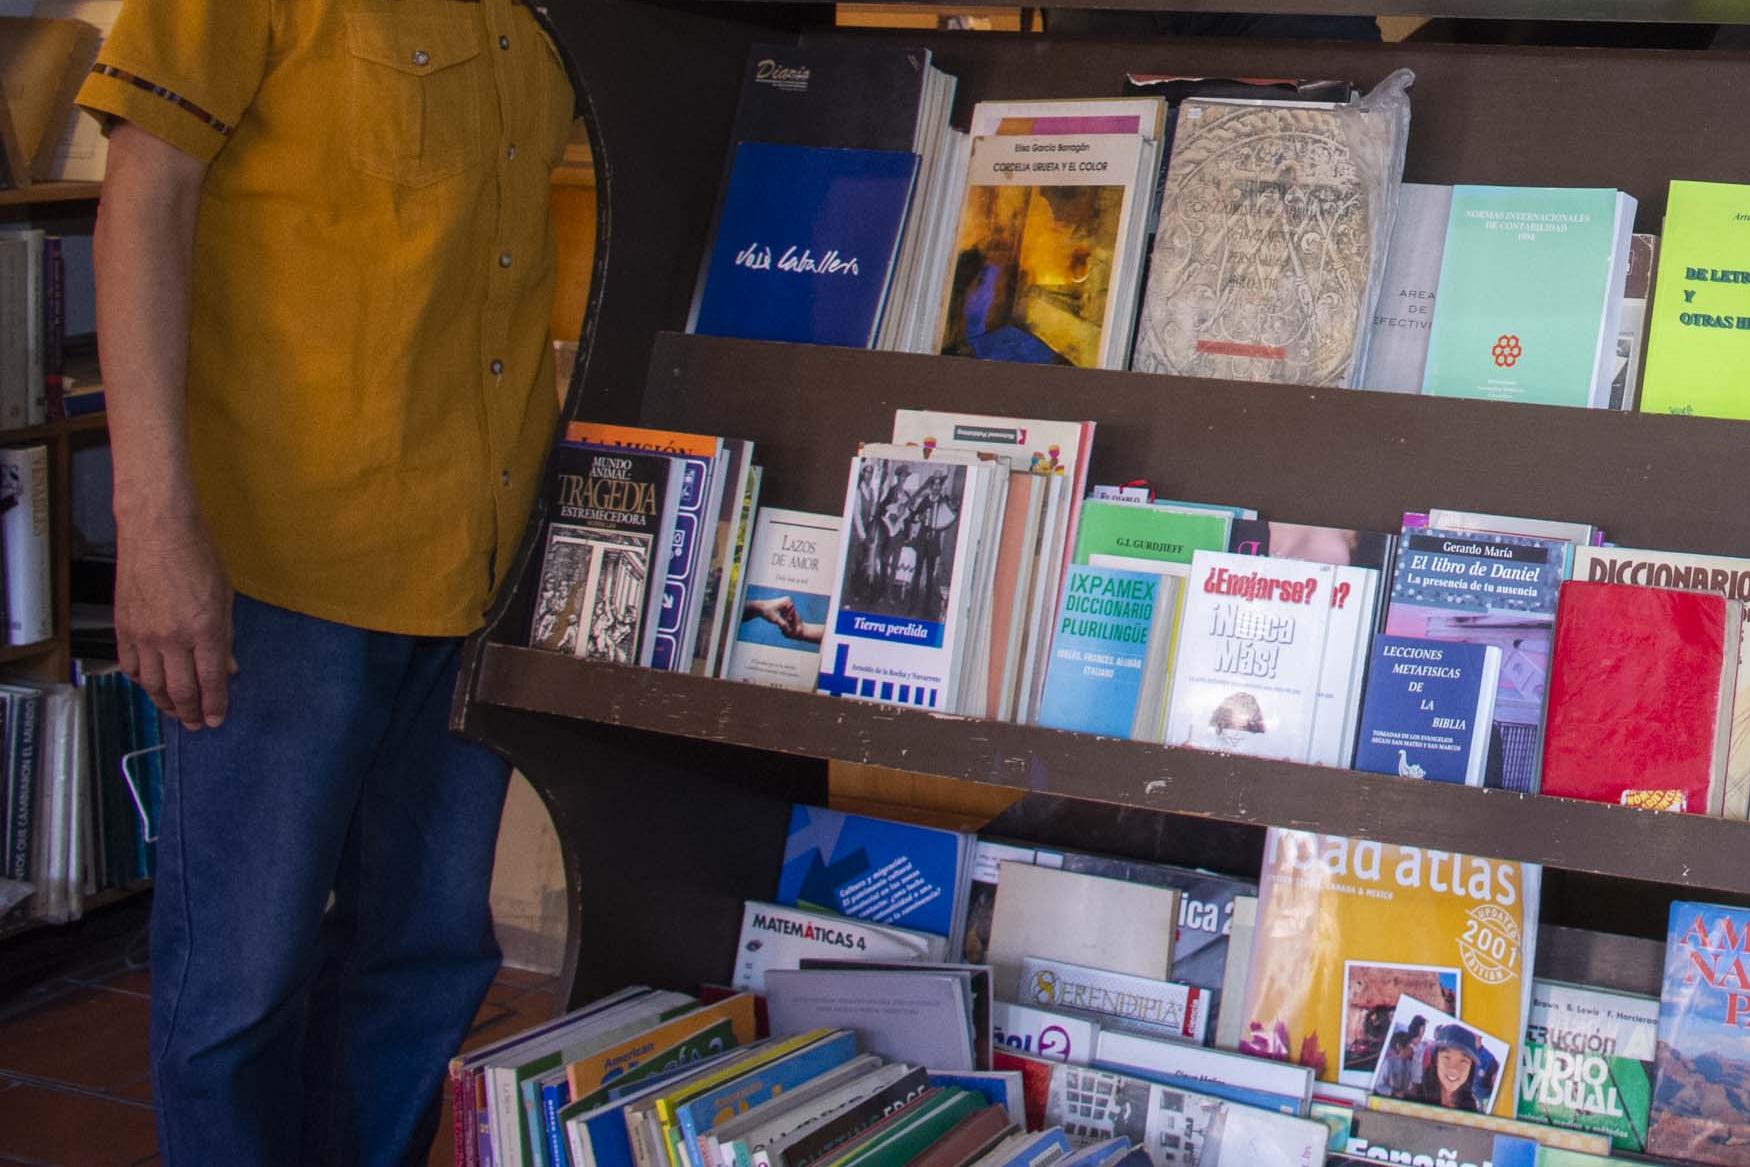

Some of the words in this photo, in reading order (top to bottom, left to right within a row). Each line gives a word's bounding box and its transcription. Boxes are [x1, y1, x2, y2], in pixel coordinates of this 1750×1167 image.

[993, 162, 1031, 172] CORDELIA
[1032, 162, 1060, 172] URUETA
[1061, 162, 1068, 171] Y
[1068, 162, 1077, 171] EL
[1079, 161, 1108, 172] COLOR
[1465, 209, 1504, 220] NORMAS
[1505, 211, 1591, 223] INTERNACIONALES
[1685, 267, 1708, 282] DE
[1683, 290, 1697, 303] Y
[1408, 305, 1428, 314] DE
[1679, 312, 1734, 329] OTRAS
[592, 456, 632, 469] MUNDO
[588, 467, 631, 480] ANIMAL:
[558, 474, 657, 516] TRAGEDIA
[560, 507, 647, 526] ESTREMECEDORA
[1443, 541, 1482, 555] Gerardo
[1484, 544, 1513, 559] María
[771, 553, 788, 567] DE
[790, 556, 819, 572] AMOR
[1411, 555, 1427, 570] El
[1431, 557, 1466, 575] libro
[1469, 561, 1486, 576] de
[1490, 564, 1540, 583] Daniel
[1070, 572, 1156, 601] IXPAMEX
[1407, 573, 1421, 584] La
[1423, 576, 1468, 591] presencia
[1470, 579, 1482, 591] de
[1483, 581, 1494, 592] tu
[1496, 583, 1538, 597] ausencia
[1066, 595, 1153, 621] DICCIONARIO
[854, 616, 886, 634] Tierra
[886, 621, 928, 638] perdida
[1061, 617, 1148, 644] PLURILINGÜE
[1214, 640, 1280, 679] Más!
[1383, 645, 1444, 660] LECCIONES
[1392, 663, 1461, 678] METAFISICAS
[1408, 681, 1424, 692] DE
[1420, 699, 1435, 710] LA
[1432, 716, 1467, 730] BIBLIA
[752, 913, 854, 949] MATEMÁTICAS
[856, 935, 867, 951] 4
[1462, 919, 1519, 968] 2001
[604, 1042, 655, 1069] American
